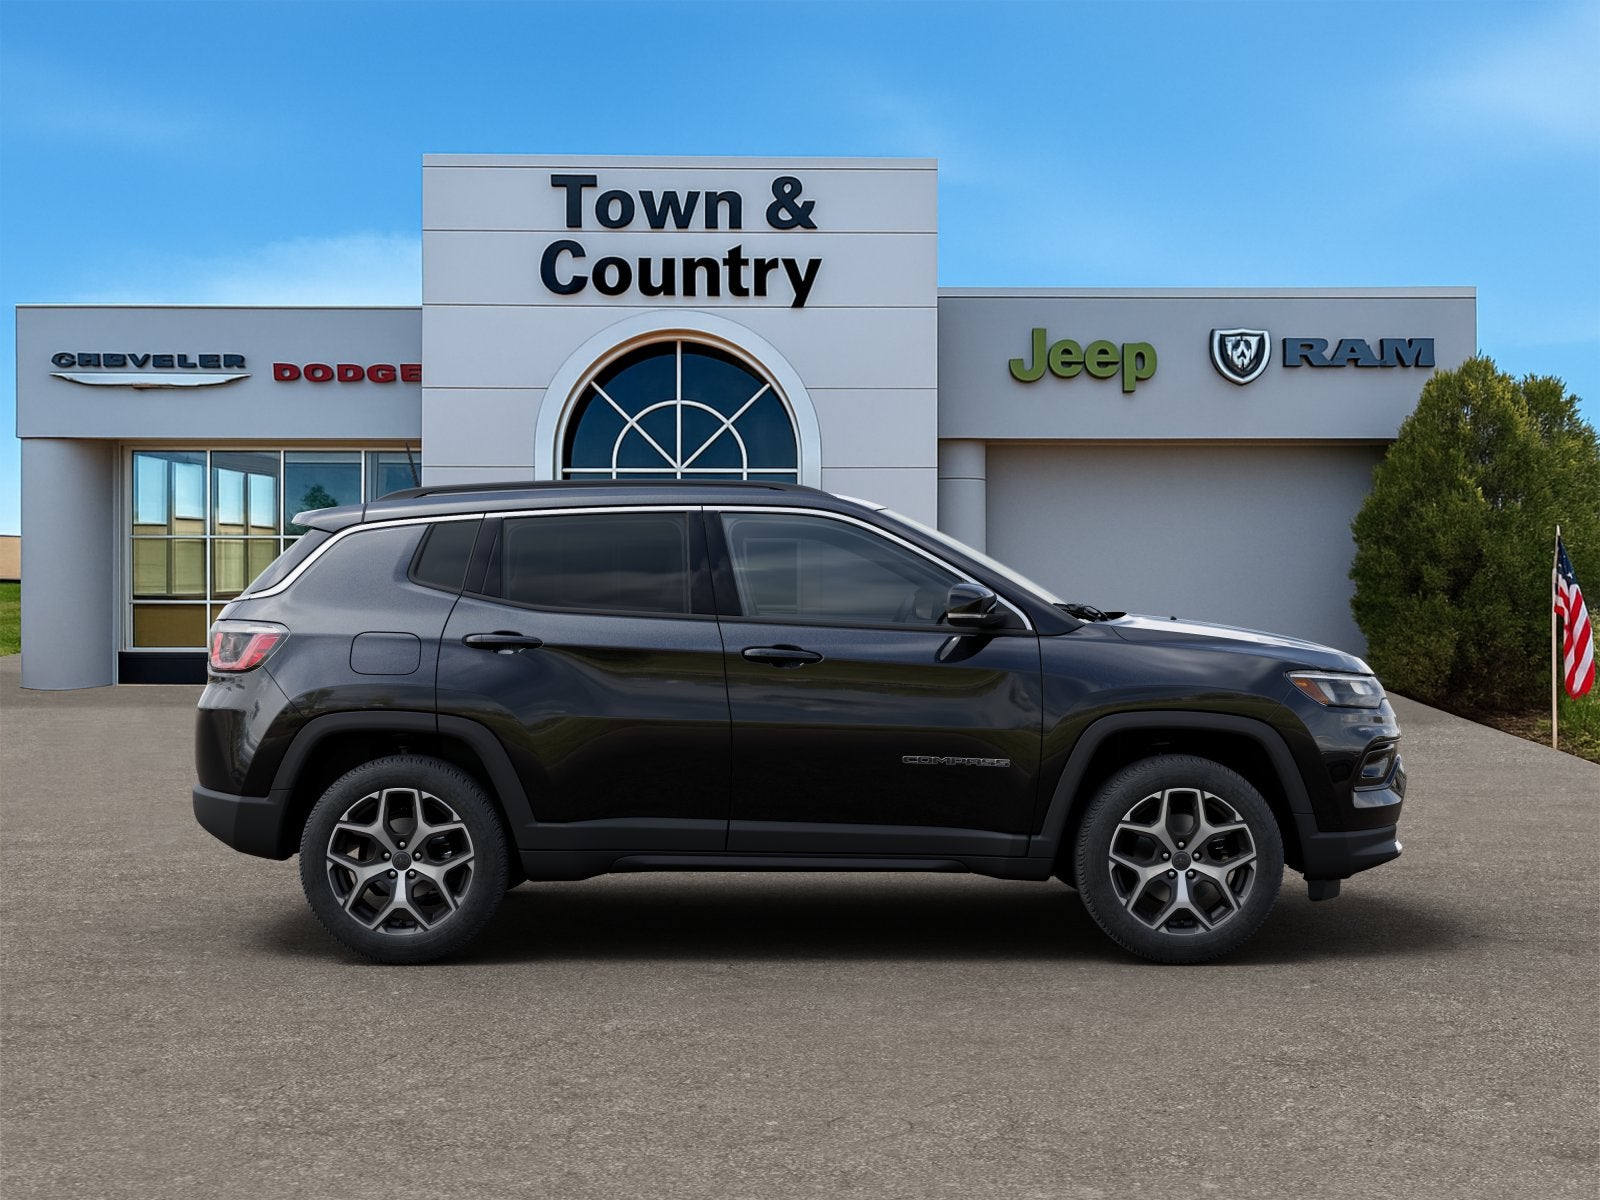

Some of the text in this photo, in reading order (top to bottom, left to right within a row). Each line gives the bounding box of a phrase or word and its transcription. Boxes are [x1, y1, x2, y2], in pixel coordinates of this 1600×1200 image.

[550, 174, 818, 230] Town &
[540, 239, 822, 308] Country
[273, 363, 422, 383] DODGE
[1009, 328, 1157, 392] Jeep
[1282, 338, 1436, 367] RAM
[902, 755, 1011, 768] COMPASS
